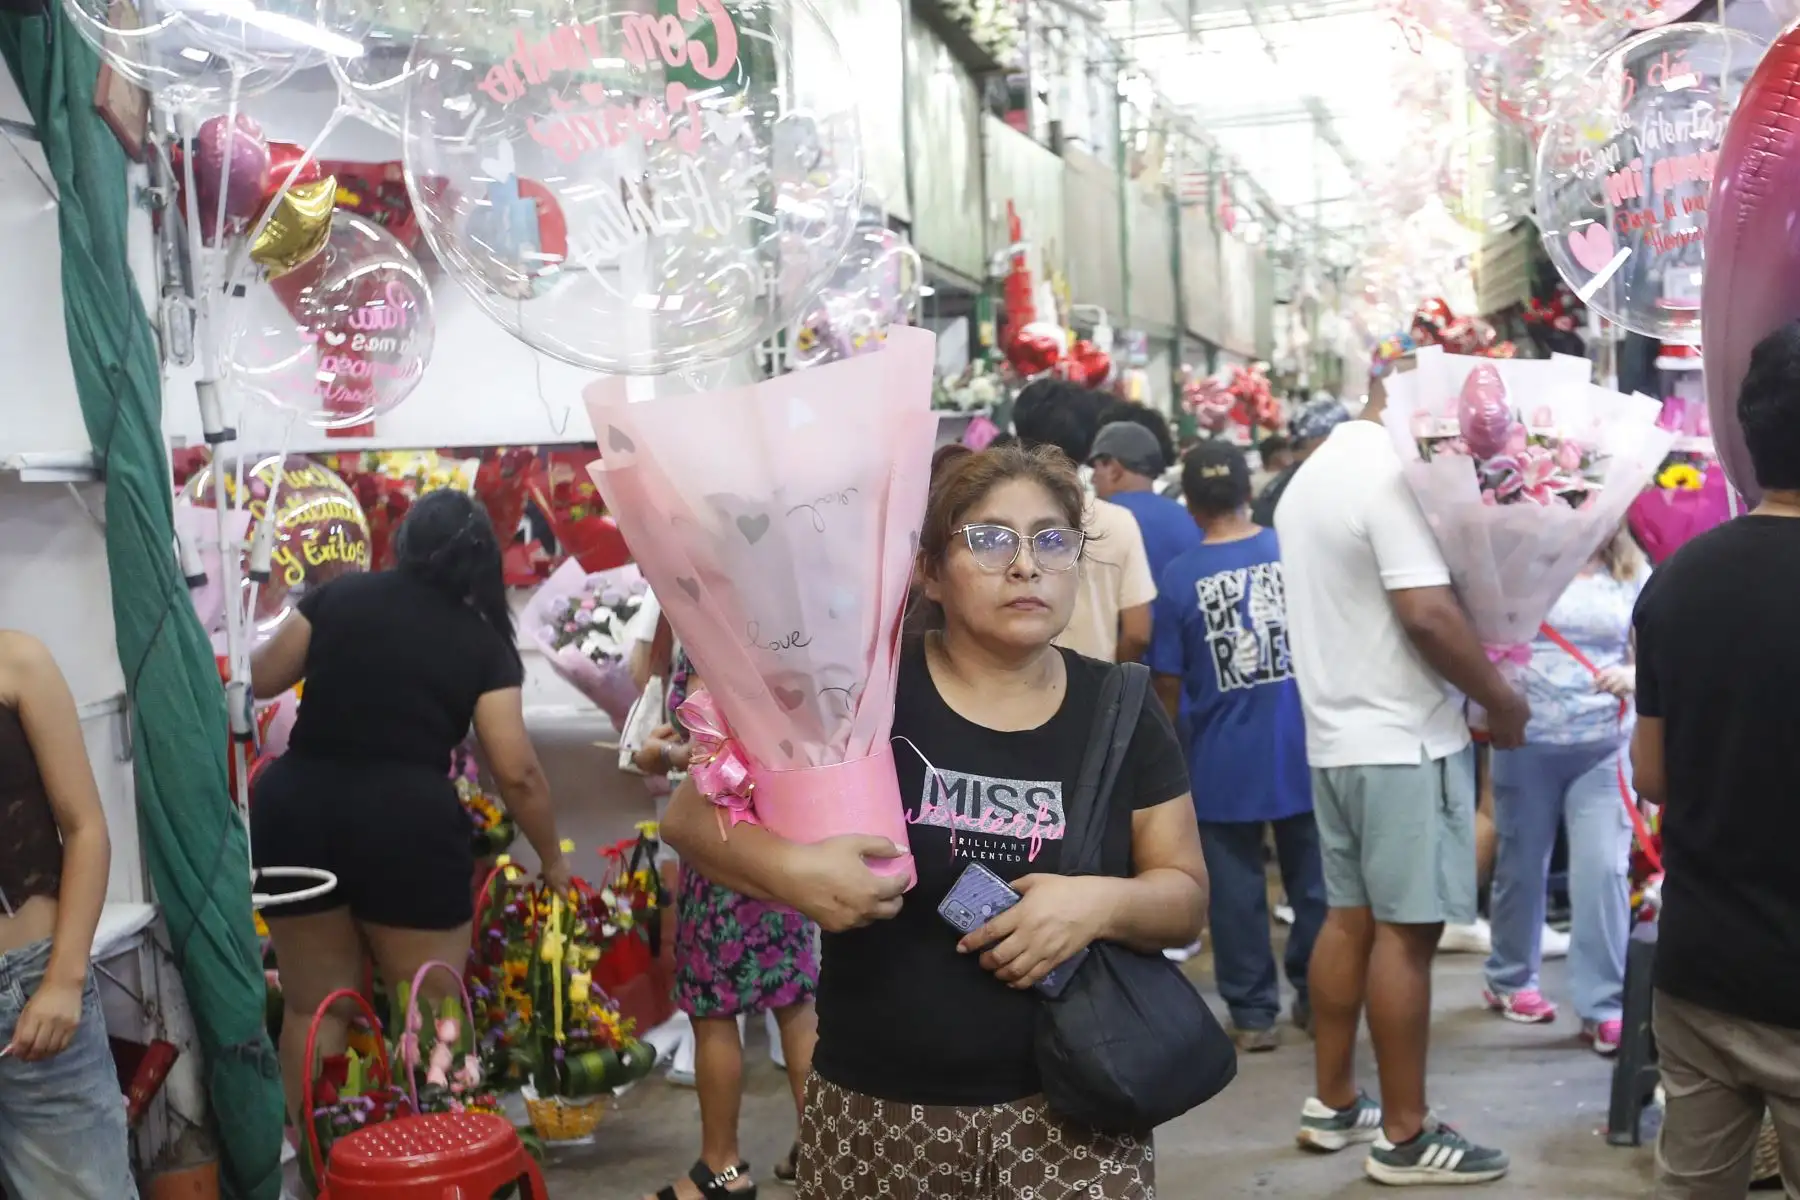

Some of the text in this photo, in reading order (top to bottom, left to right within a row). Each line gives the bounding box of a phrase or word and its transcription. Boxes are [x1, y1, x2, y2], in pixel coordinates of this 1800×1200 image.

[742, 620, 813, 651] love
[929, 773, 1059, 826] MISS
[904, 801, 1066, 863] wonderfu
[954, 848, 1021, 863] TALENTED
